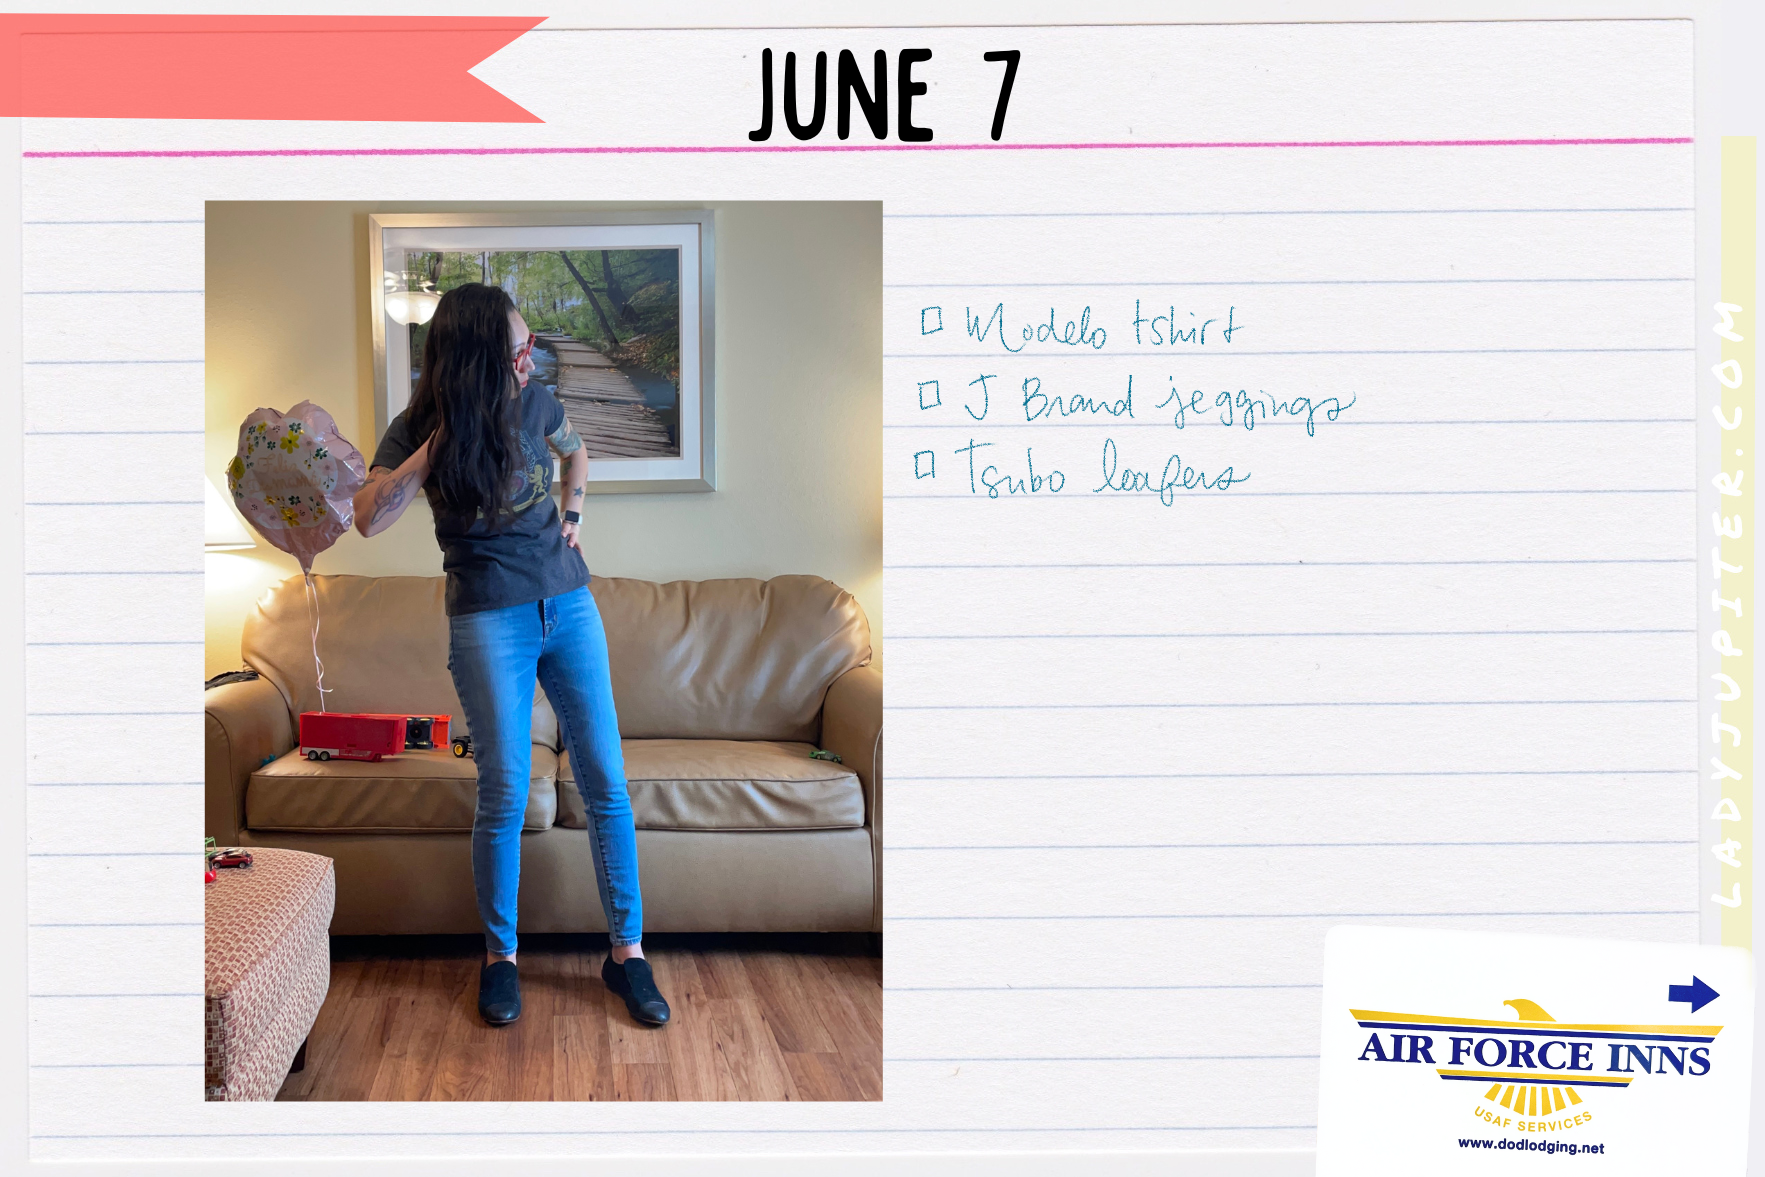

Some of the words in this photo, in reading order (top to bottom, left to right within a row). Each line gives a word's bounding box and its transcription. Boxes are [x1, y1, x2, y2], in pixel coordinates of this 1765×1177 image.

[965, 302, 1108, 353] Modelo
[1132, 299, 1246, 346] tshirt
[964, 374, 998, 421] J
[1021, 375, 1135, 422] Brand
[1155, 375, 1357, 437] jeggings
[954, 438, 1066, 499] Tsubo
[1092, 438, 1252, 507] loafers
[1358, 1032, 1437, 1064] AIR
[1447, 1036, 1594, 1072] FORCE
[1606, 1043, 1713, 1077] INNS
[1474, 1106, 1512, 1129] USAF
[1517, 1110, 1593, 1133] SERVICES
[1458, 1137, 1605, 1156] www.dodlodging.net
